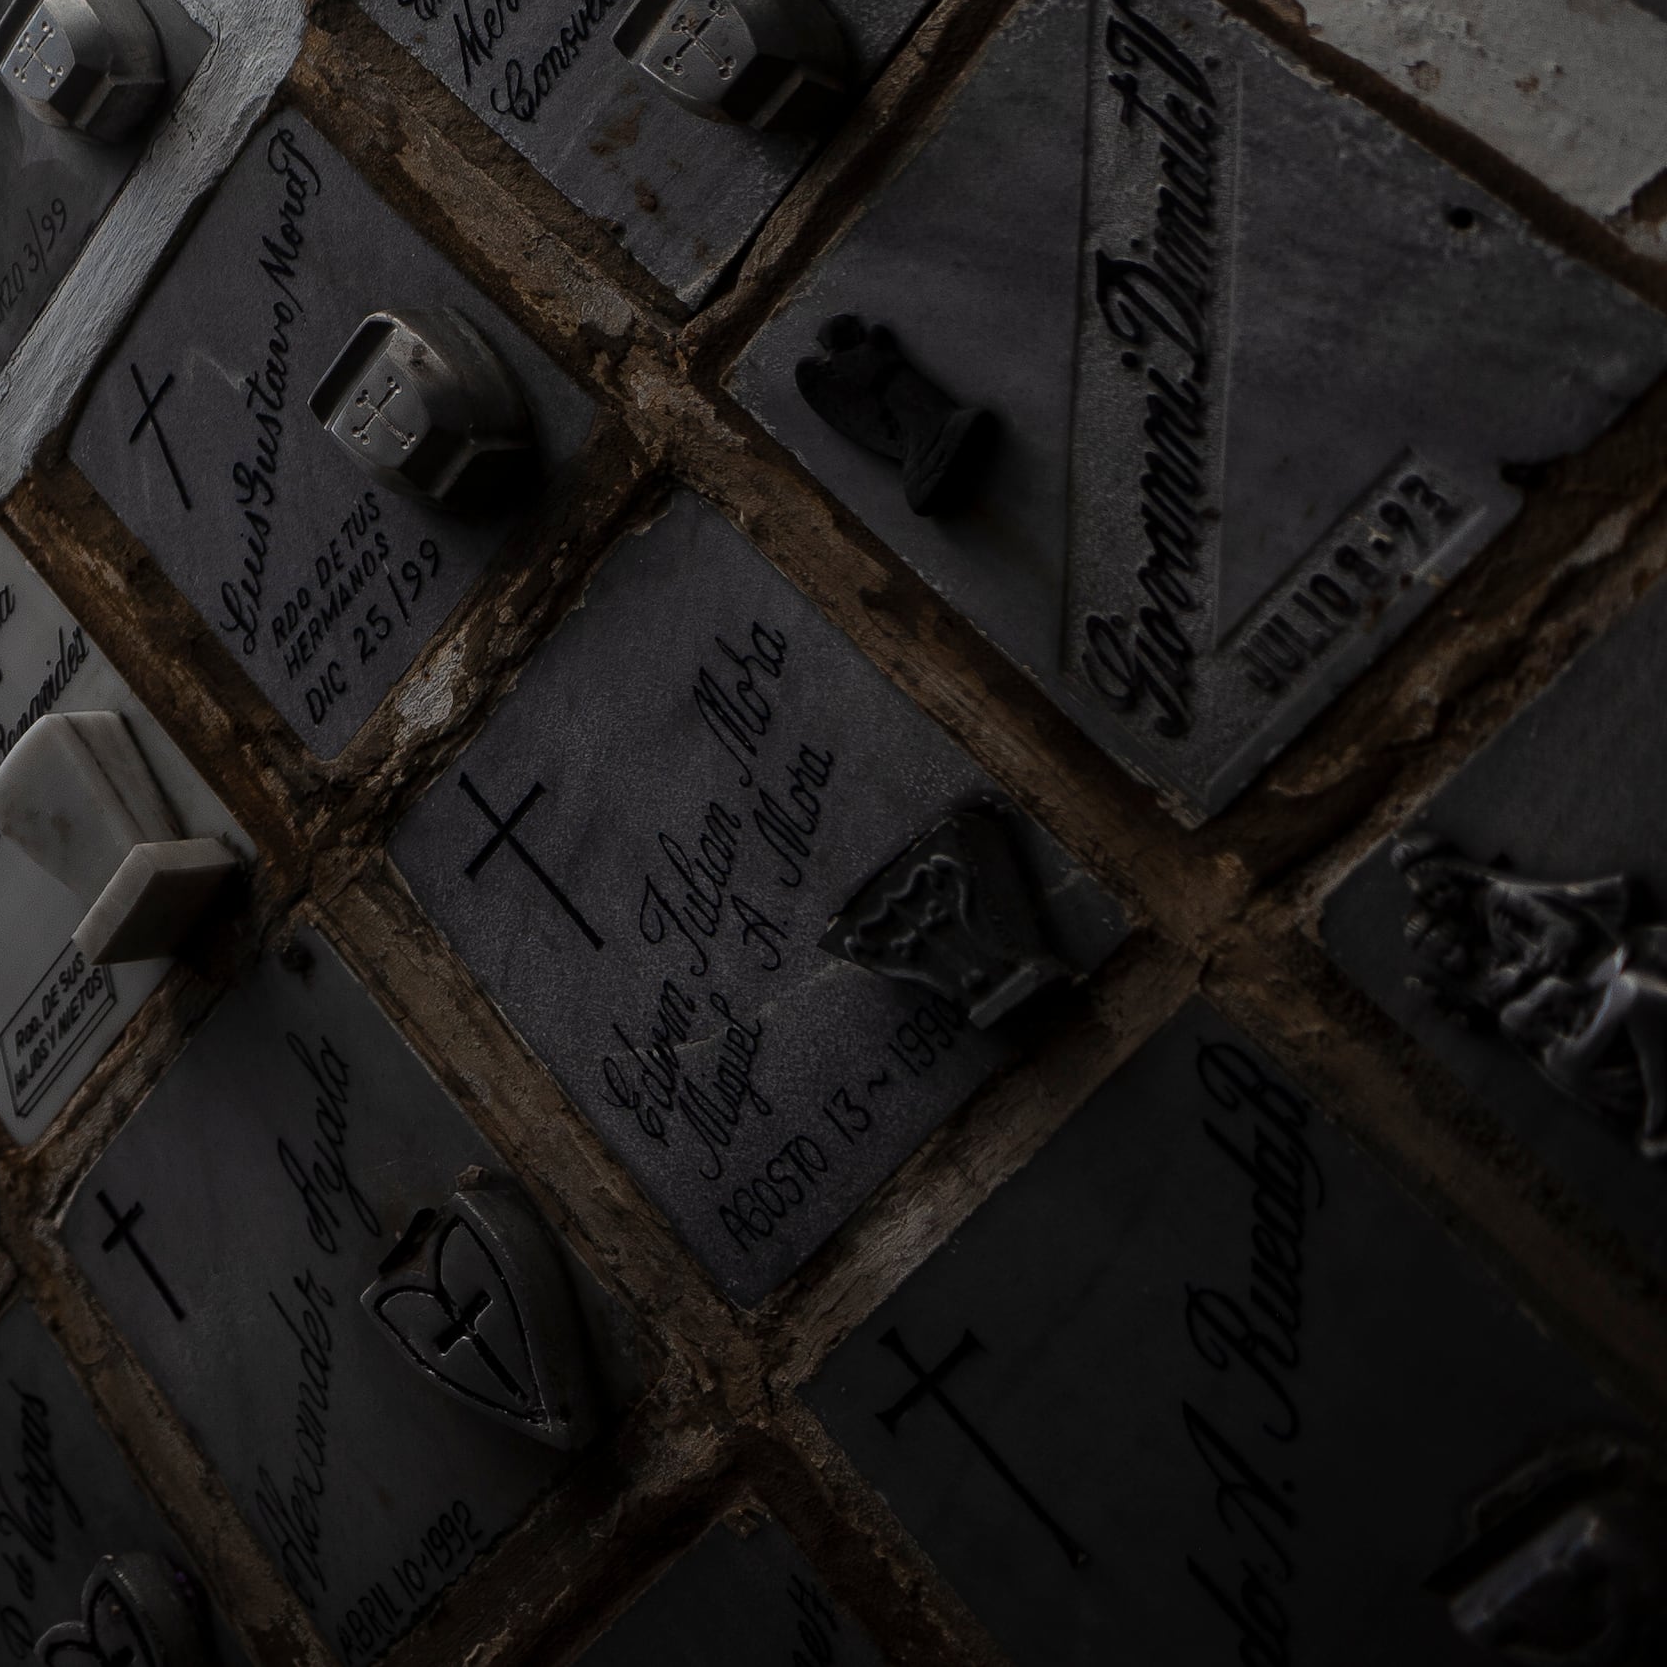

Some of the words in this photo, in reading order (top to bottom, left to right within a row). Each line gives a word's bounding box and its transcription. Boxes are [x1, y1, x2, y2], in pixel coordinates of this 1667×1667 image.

[23, 197, 75, 287] 3/99
[259, 180, 307, 312] Mora
[236, 301, 295, 537] Gustavo
[221, 510, 271, 655] Luis
[267, 584, 314, 649] RDO
[309, 535, 350, 593] DE
[340, 491, 381, 548] TUS
[286, 531, 390, 679] HERMANOS
[305, 661, 348, 725] DIC
[353, 538, 443, 665] 25/99
[1241, 574, 1360, 698] JULIO
[692, 621, 788, 788] Mora
[639, 801, 738, 978] Julian
[679, 991, 773, 1182] Miguel
[754, 743, 835, 889] Mora
[10, 1009, 45, 1055] RDO.
[39, 980, 63, 1020] DE
[57, 948, 87, 994] SUS
[15, 1039, 49, 1095] HIJOS
[58, 958, 113, 1038] NIETOS
[602, 979, 695, 1148] Edwin
[276, 1033, 383, 1255] Ayala
[717, 1134, 829, 1253] AGOSTO
[822, 1086, 873, 1145] 13
[1184, 1118, 1306, 1444] Rueda
[266, 1276, 335, 1619] Alexander
[338, 1582, 416, 1667] ABRIL
